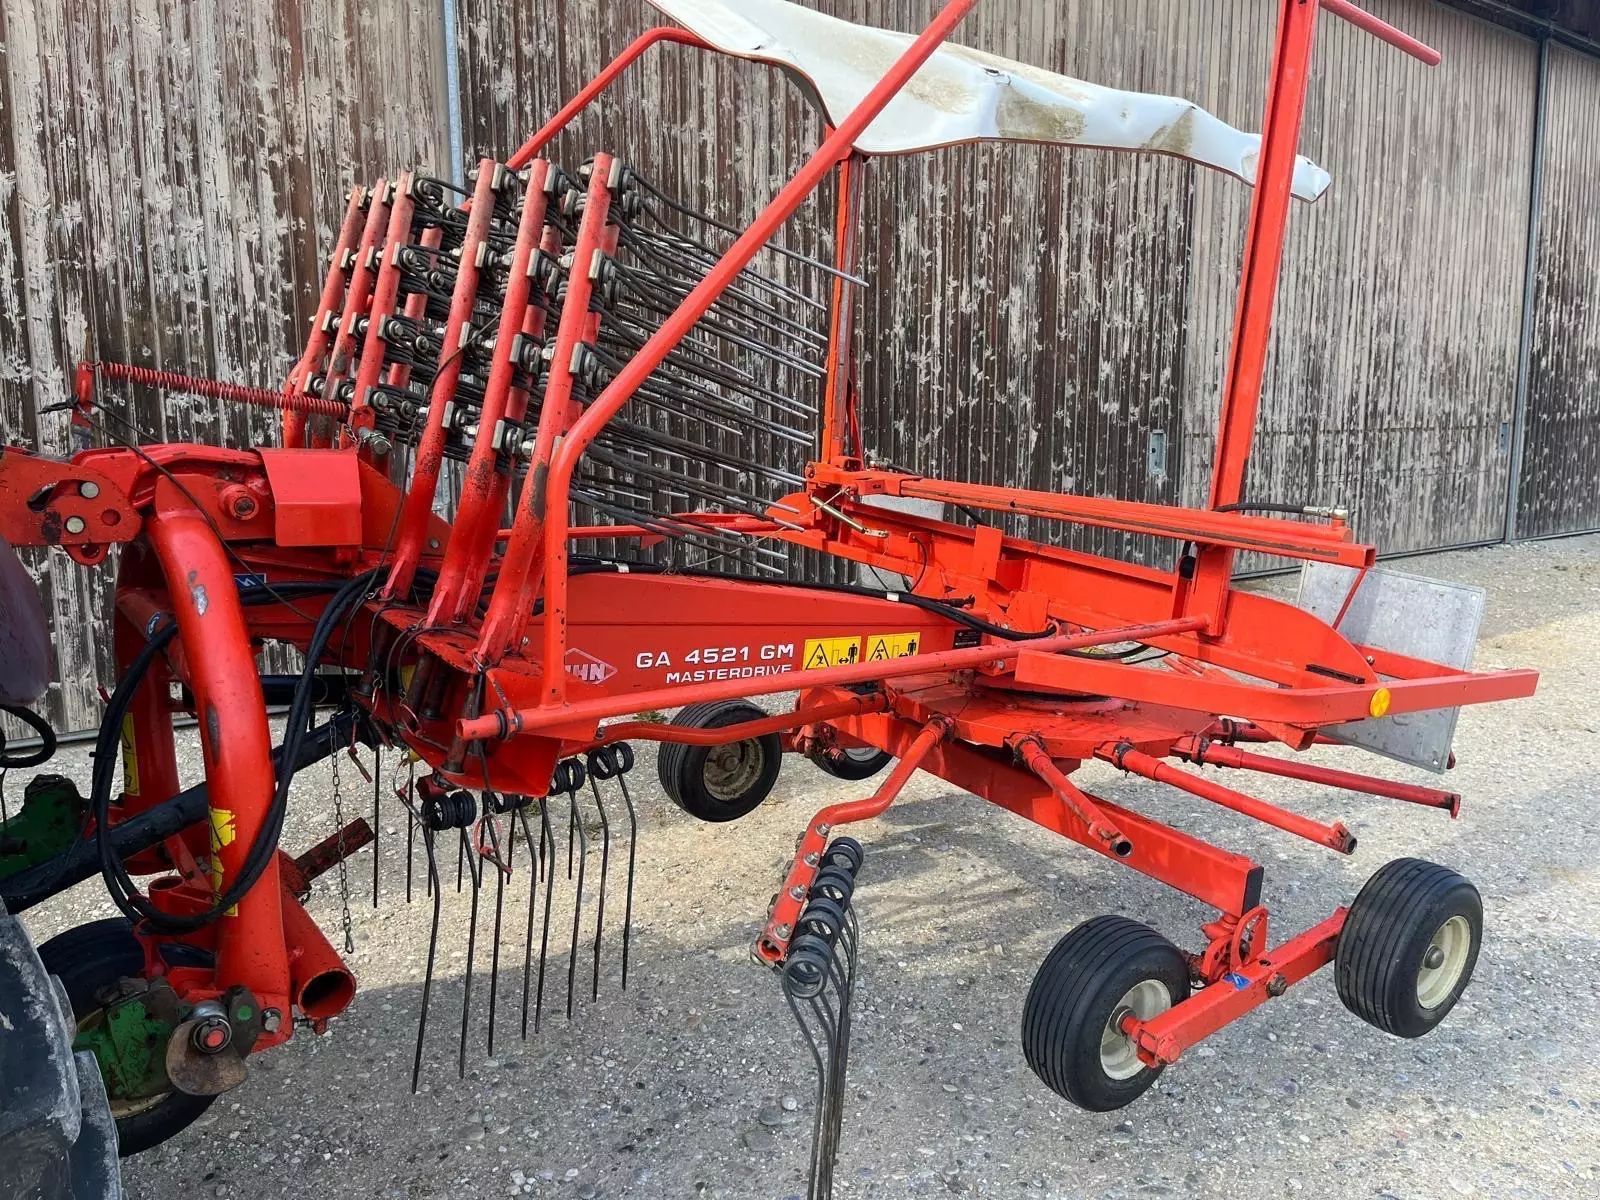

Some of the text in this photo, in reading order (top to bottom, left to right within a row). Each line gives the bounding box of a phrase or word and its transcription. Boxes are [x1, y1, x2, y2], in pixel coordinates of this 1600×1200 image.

[636, 643, 794, 669] GA 4521 GM
[564, 663, 606, 681] HN
[666, 663, 792, 684] MASTERDRIVE
